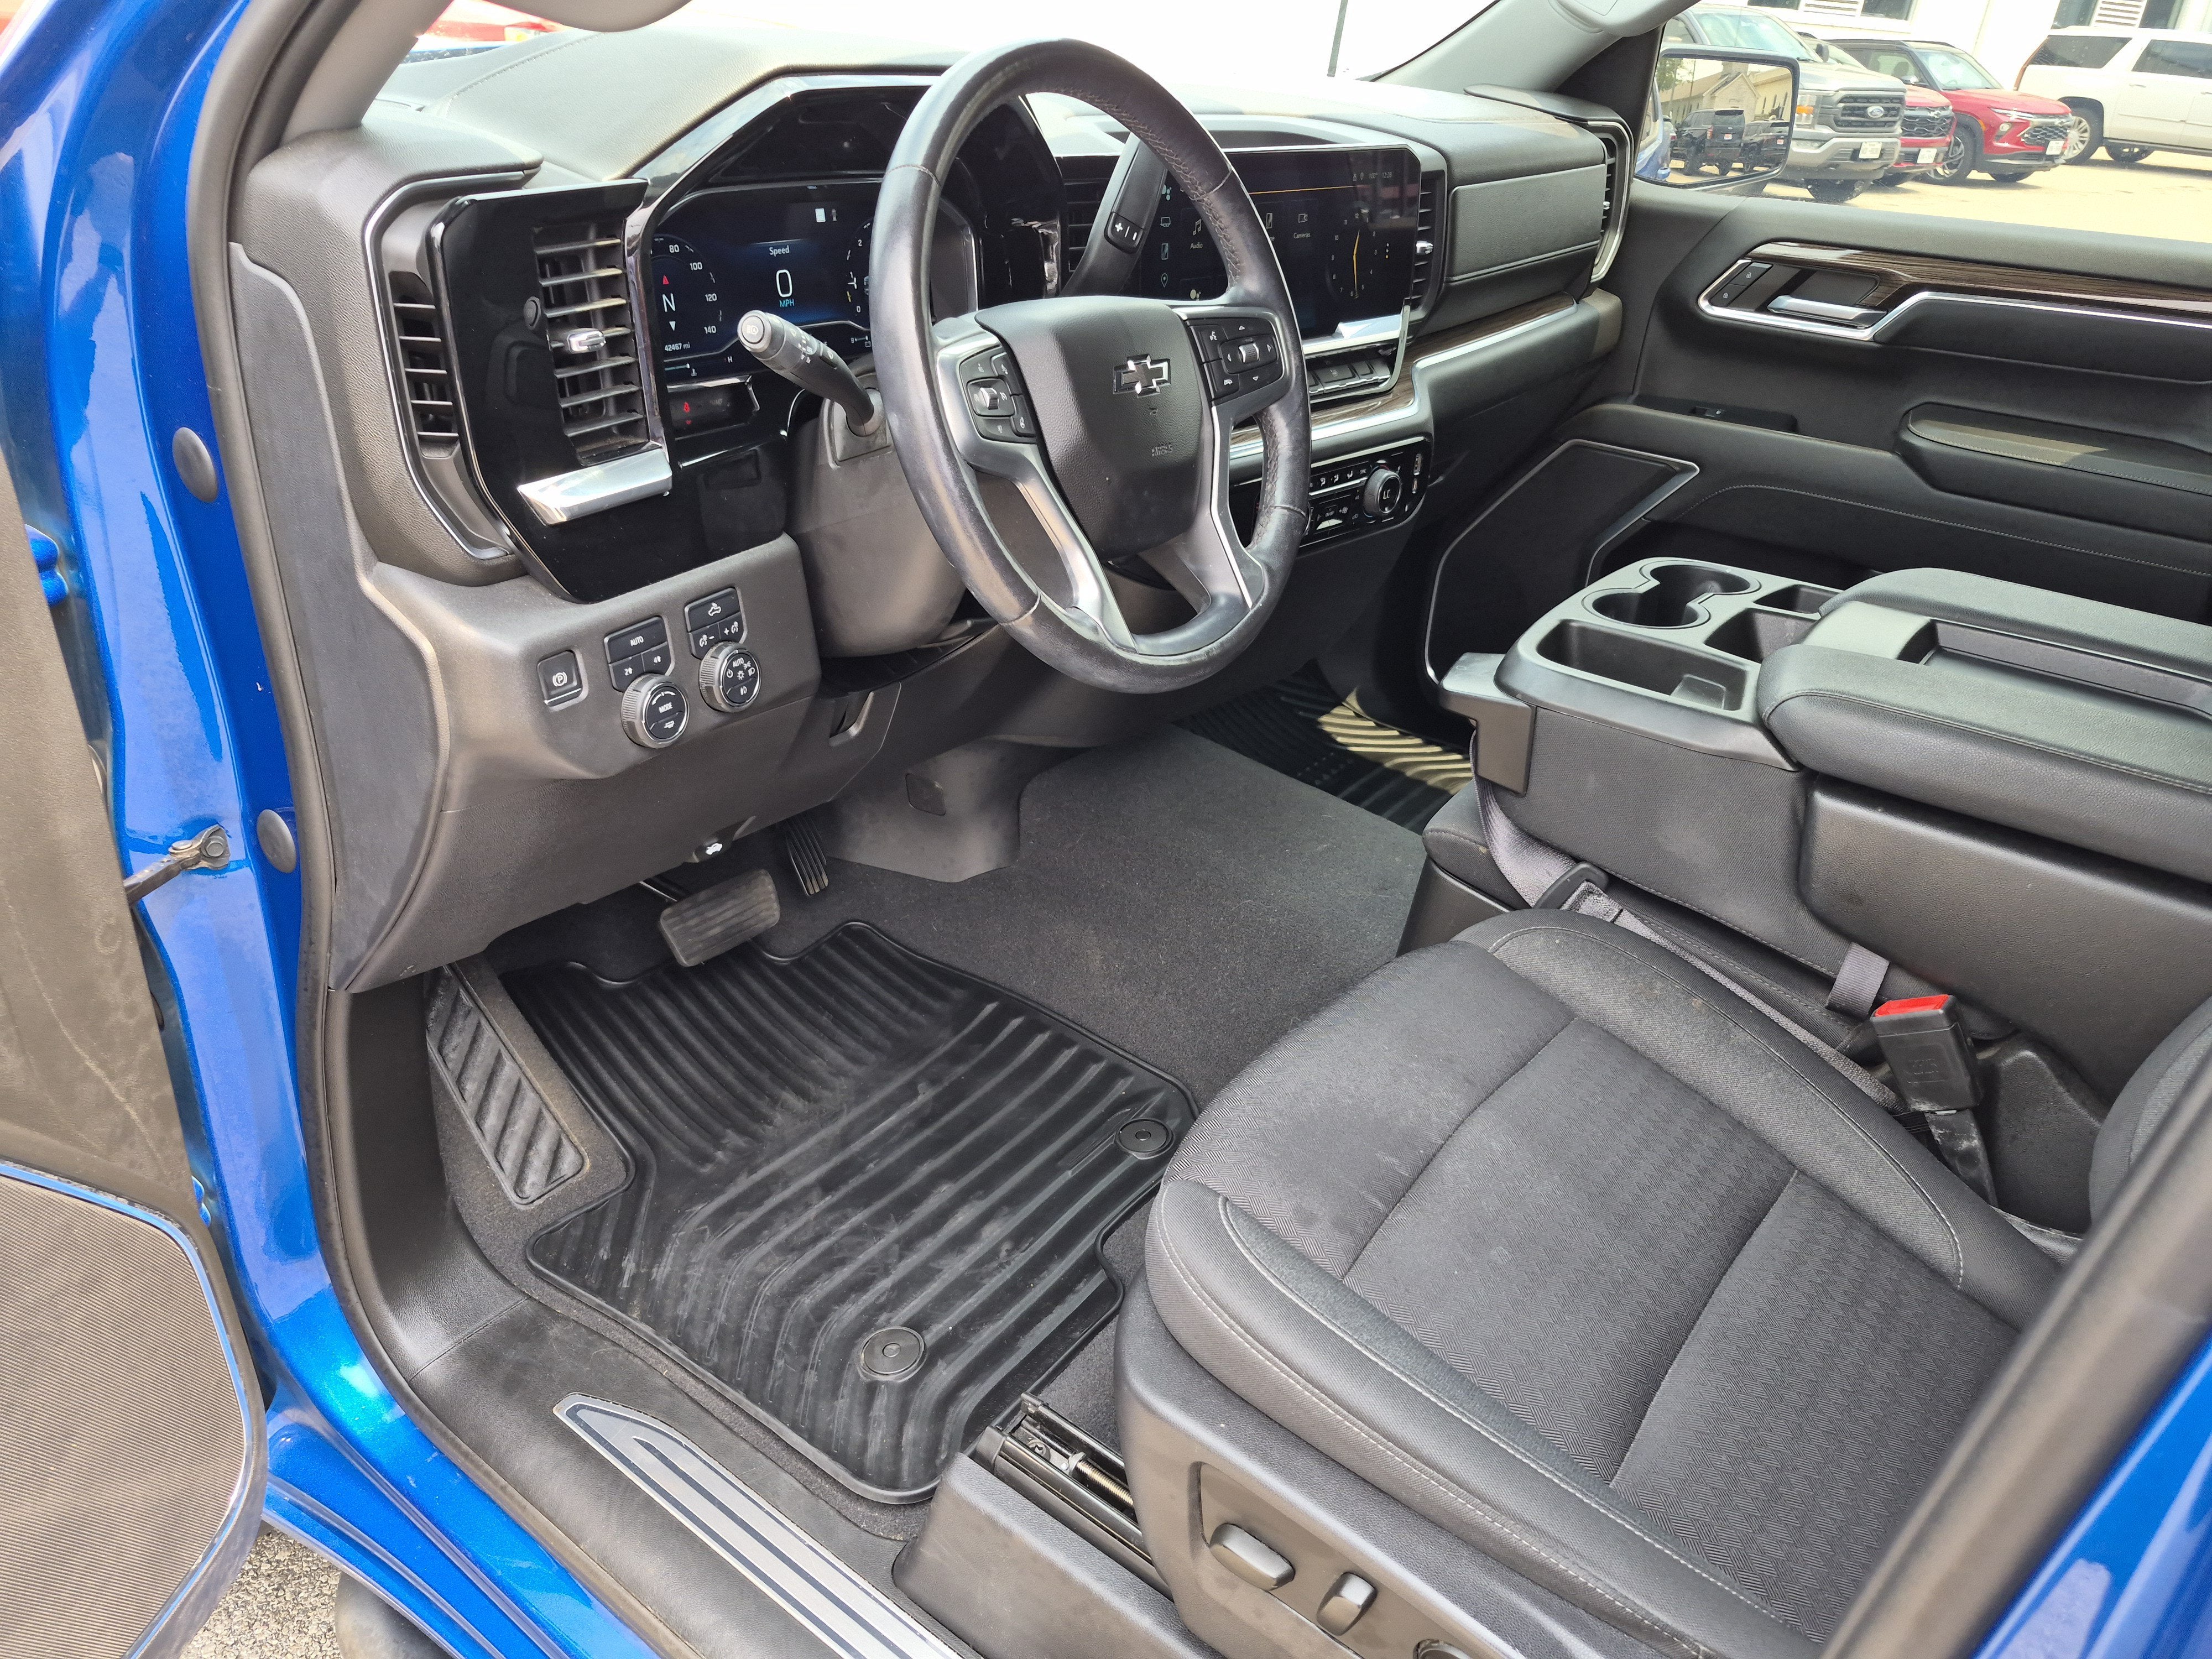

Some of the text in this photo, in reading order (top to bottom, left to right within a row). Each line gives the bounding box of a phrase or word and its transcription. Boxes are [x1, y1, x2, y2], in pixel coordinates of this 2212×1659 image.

[669, 244, 680, 253] 80
[769, 244, 790, 257] Speed
[689, 262, 703, 271] 100
[776, 269, 793, 298] 0
[662, 293, 676, 312] N
[705, 293, 718, 302] 120
[779, 299, 795, 308] MPH
[703, 325, 717, 335] 140
[664, 341, 691, 352] 42467 mi
[630, 635, 644, 647] AUTO
[733, 657, 744, 668] AUTO
[658, 702, 673, 713] MODE
